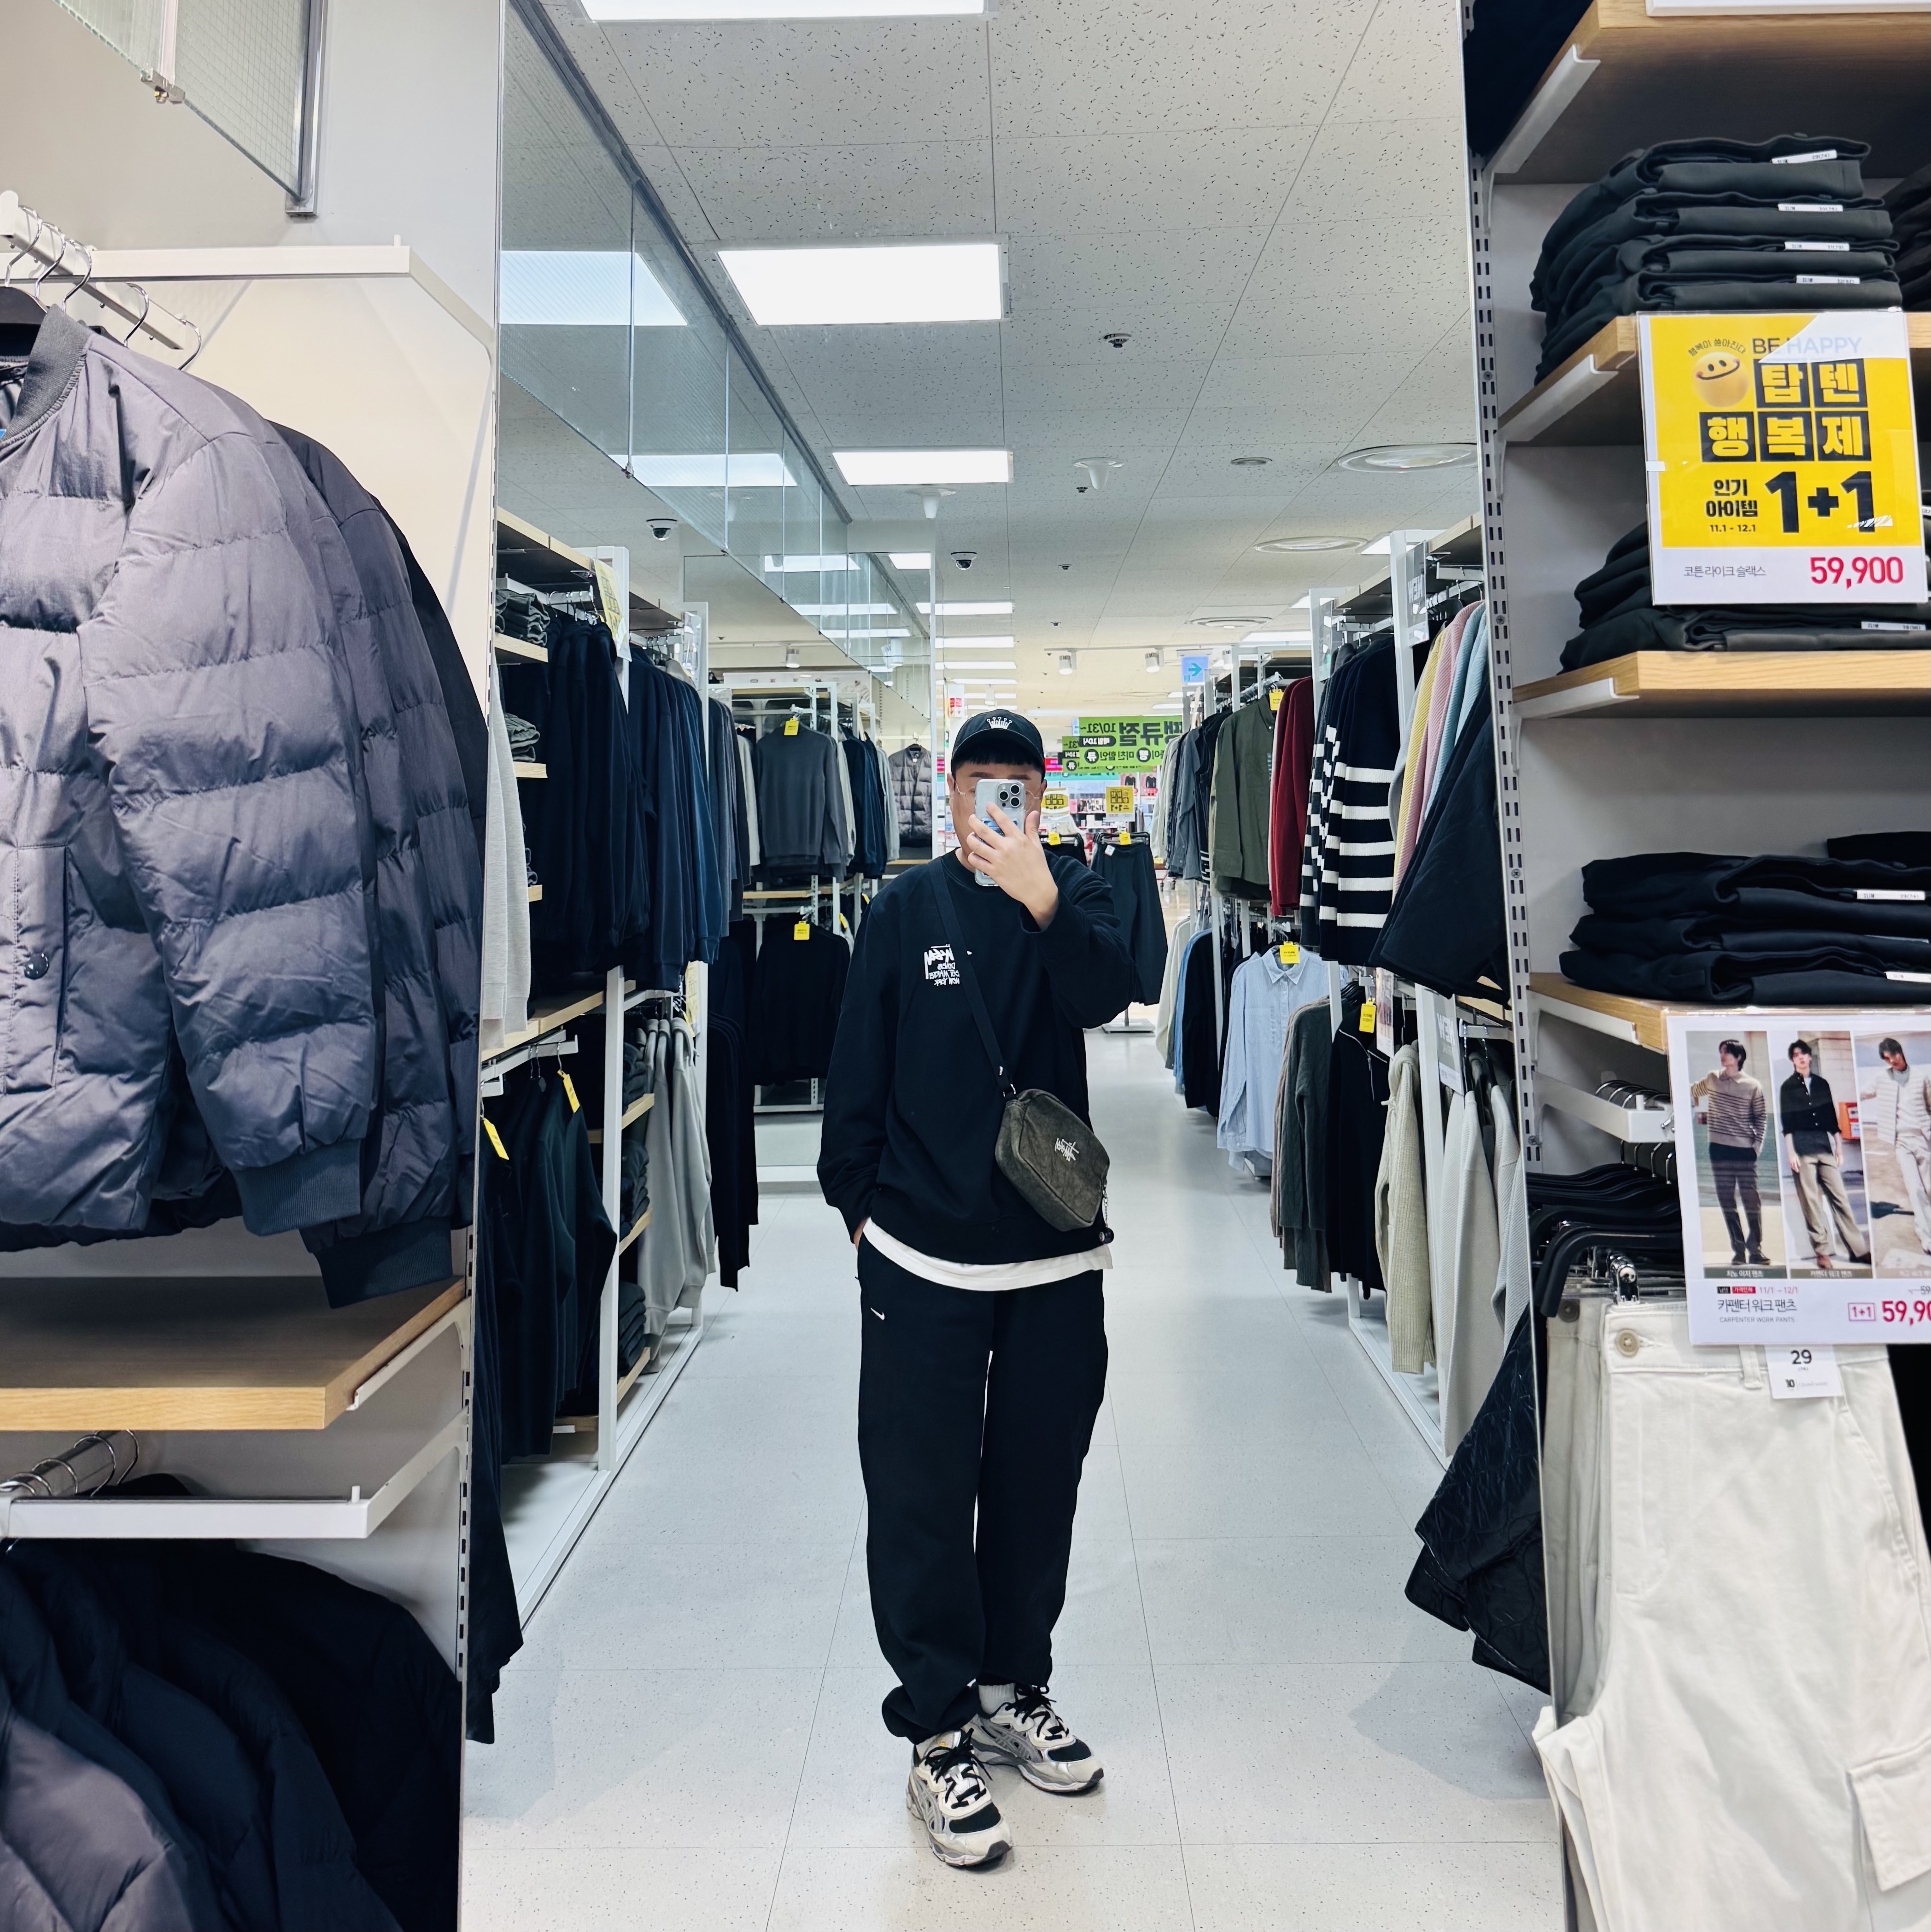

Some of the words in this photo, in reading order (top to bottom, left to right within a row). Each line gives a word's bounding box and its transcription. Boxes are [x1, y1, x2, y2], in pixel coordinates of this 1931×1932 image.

[1752, 337, 1780, 355] BE
[1786, 337, 1862, 354] HAPPY
[1760, 362, 1861, 404] 탑텐
[1706, 416, 1865, 458] 행복제
[1713, 479, 1748, 497] 인기
[1705, 500, 1758, 517] 아이템
[1764, 471, 1876, 533] 1+1
[1709, 524, 1726, 533] 11.1
[1737, 524, 1756, 533] 12.1
[1736, 565, 1767, 578] 슬랙스
[1810, 556, 1904, 590] 59,900
[1717, 1299, 1750, 1312] 카펜터
[1751, 1299, 1774, 1312] 워크
[1774, 1299, 1797, 1312] 팬츠
[1852, 1306, 1871, 1318] 1+1
[1790, 1349, 1812, 1365] 29
